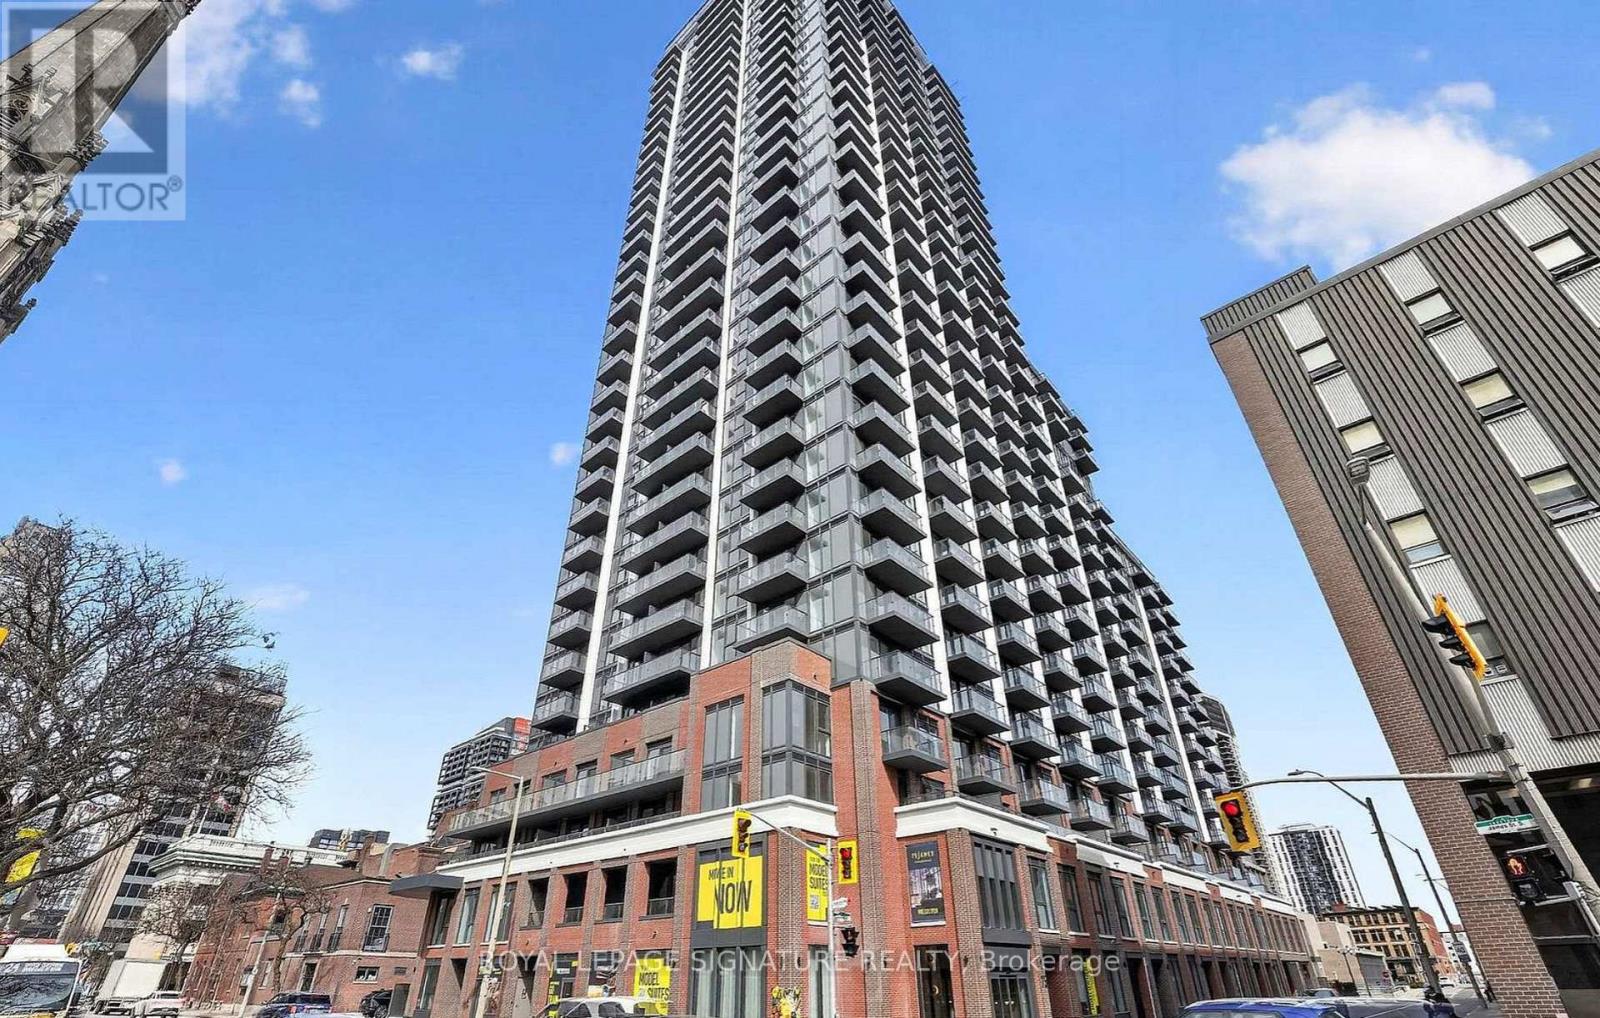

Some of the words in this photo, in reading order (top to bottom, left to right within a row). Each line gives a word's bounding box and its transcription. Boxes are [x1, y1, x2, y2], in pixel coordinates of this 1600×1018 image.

[727, 866, 734, 878] IN
[714, 880, 753, 914] NOW
[639, 972, 660, 986] MODEL
[648, 987, 670, 1001] SUITES
